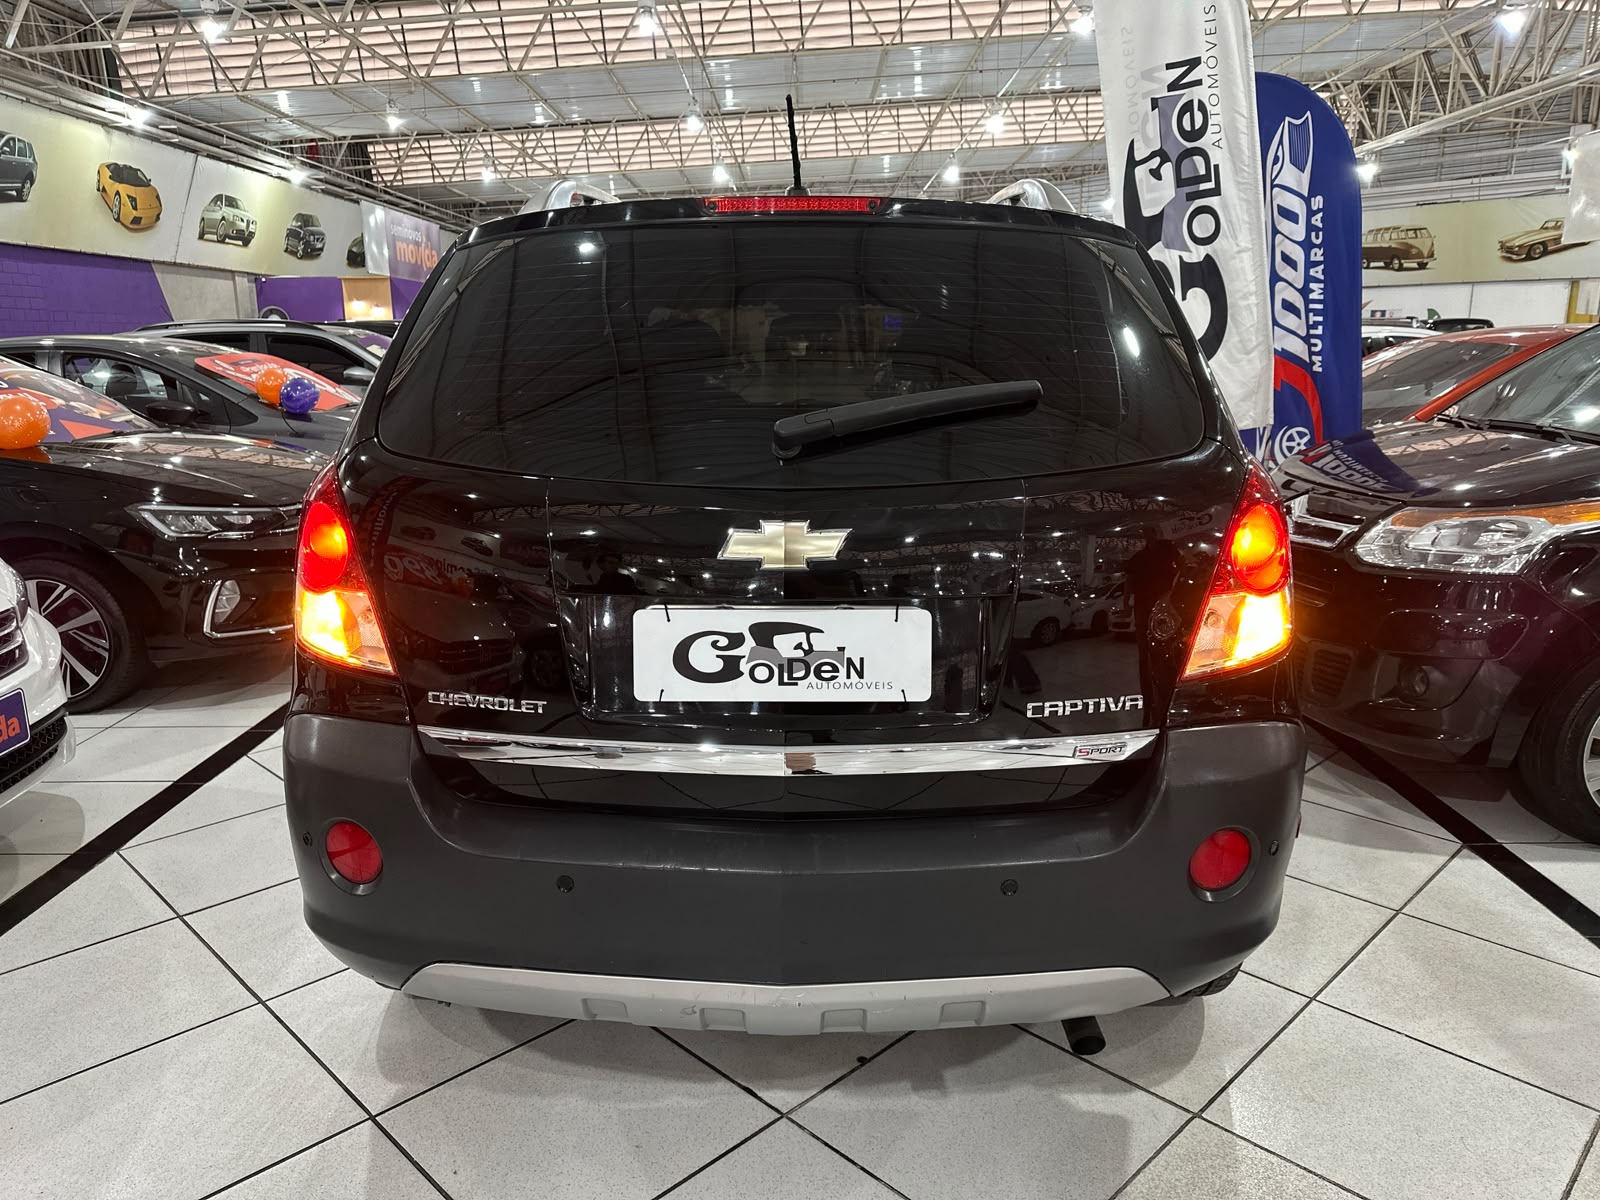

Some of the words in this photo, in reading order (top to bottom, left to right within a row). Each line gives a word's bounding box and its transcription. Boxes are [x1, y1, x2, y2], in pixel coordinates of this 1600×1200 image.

[1203, 4, 1223, 149] AUTOMÓVEIS
[391, 224, 422, 242] seminovos
[396, 236, 438, 271] movida
[1308, 195, 1325, 372] MULTIMARCAS
[806, 679, 893, 690] AUTOMÓVEIS
[428, 691, 547, 713] CHEVROLET
[1026, 694, 1144, 718] CAPTIVA
[1077, 746, 1126, 757] SPORT
